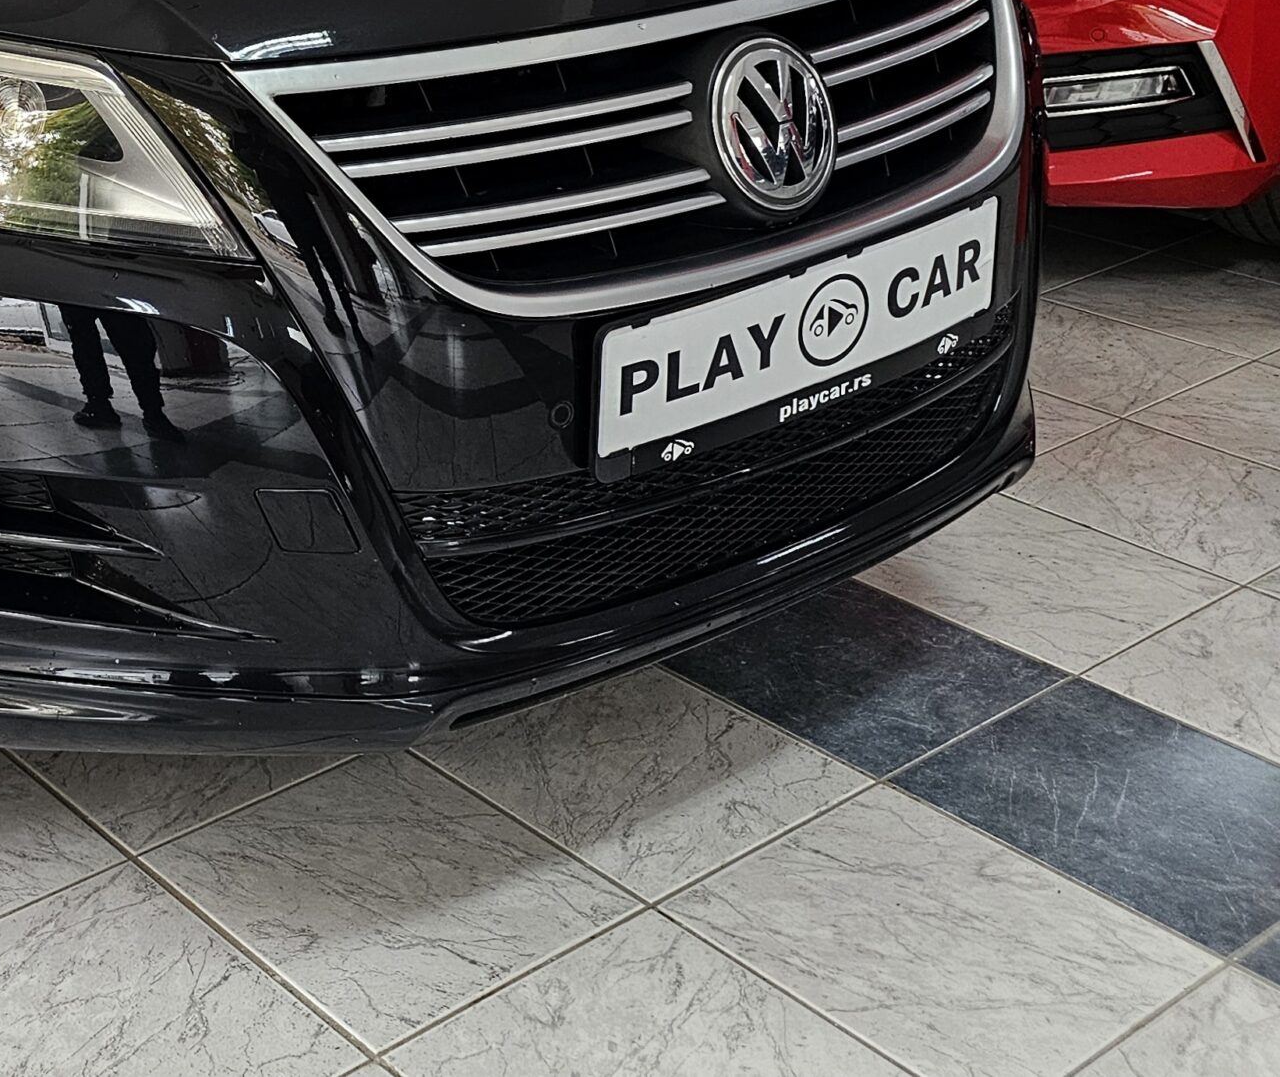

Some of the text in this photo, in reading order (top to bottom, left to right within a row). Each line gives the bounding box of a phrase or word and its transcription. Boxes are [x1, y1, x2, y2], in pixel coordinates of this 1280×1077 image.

[619, 238, 982, 416] PLAY CAR
[779, 373, 872, 422] playcar.rs
